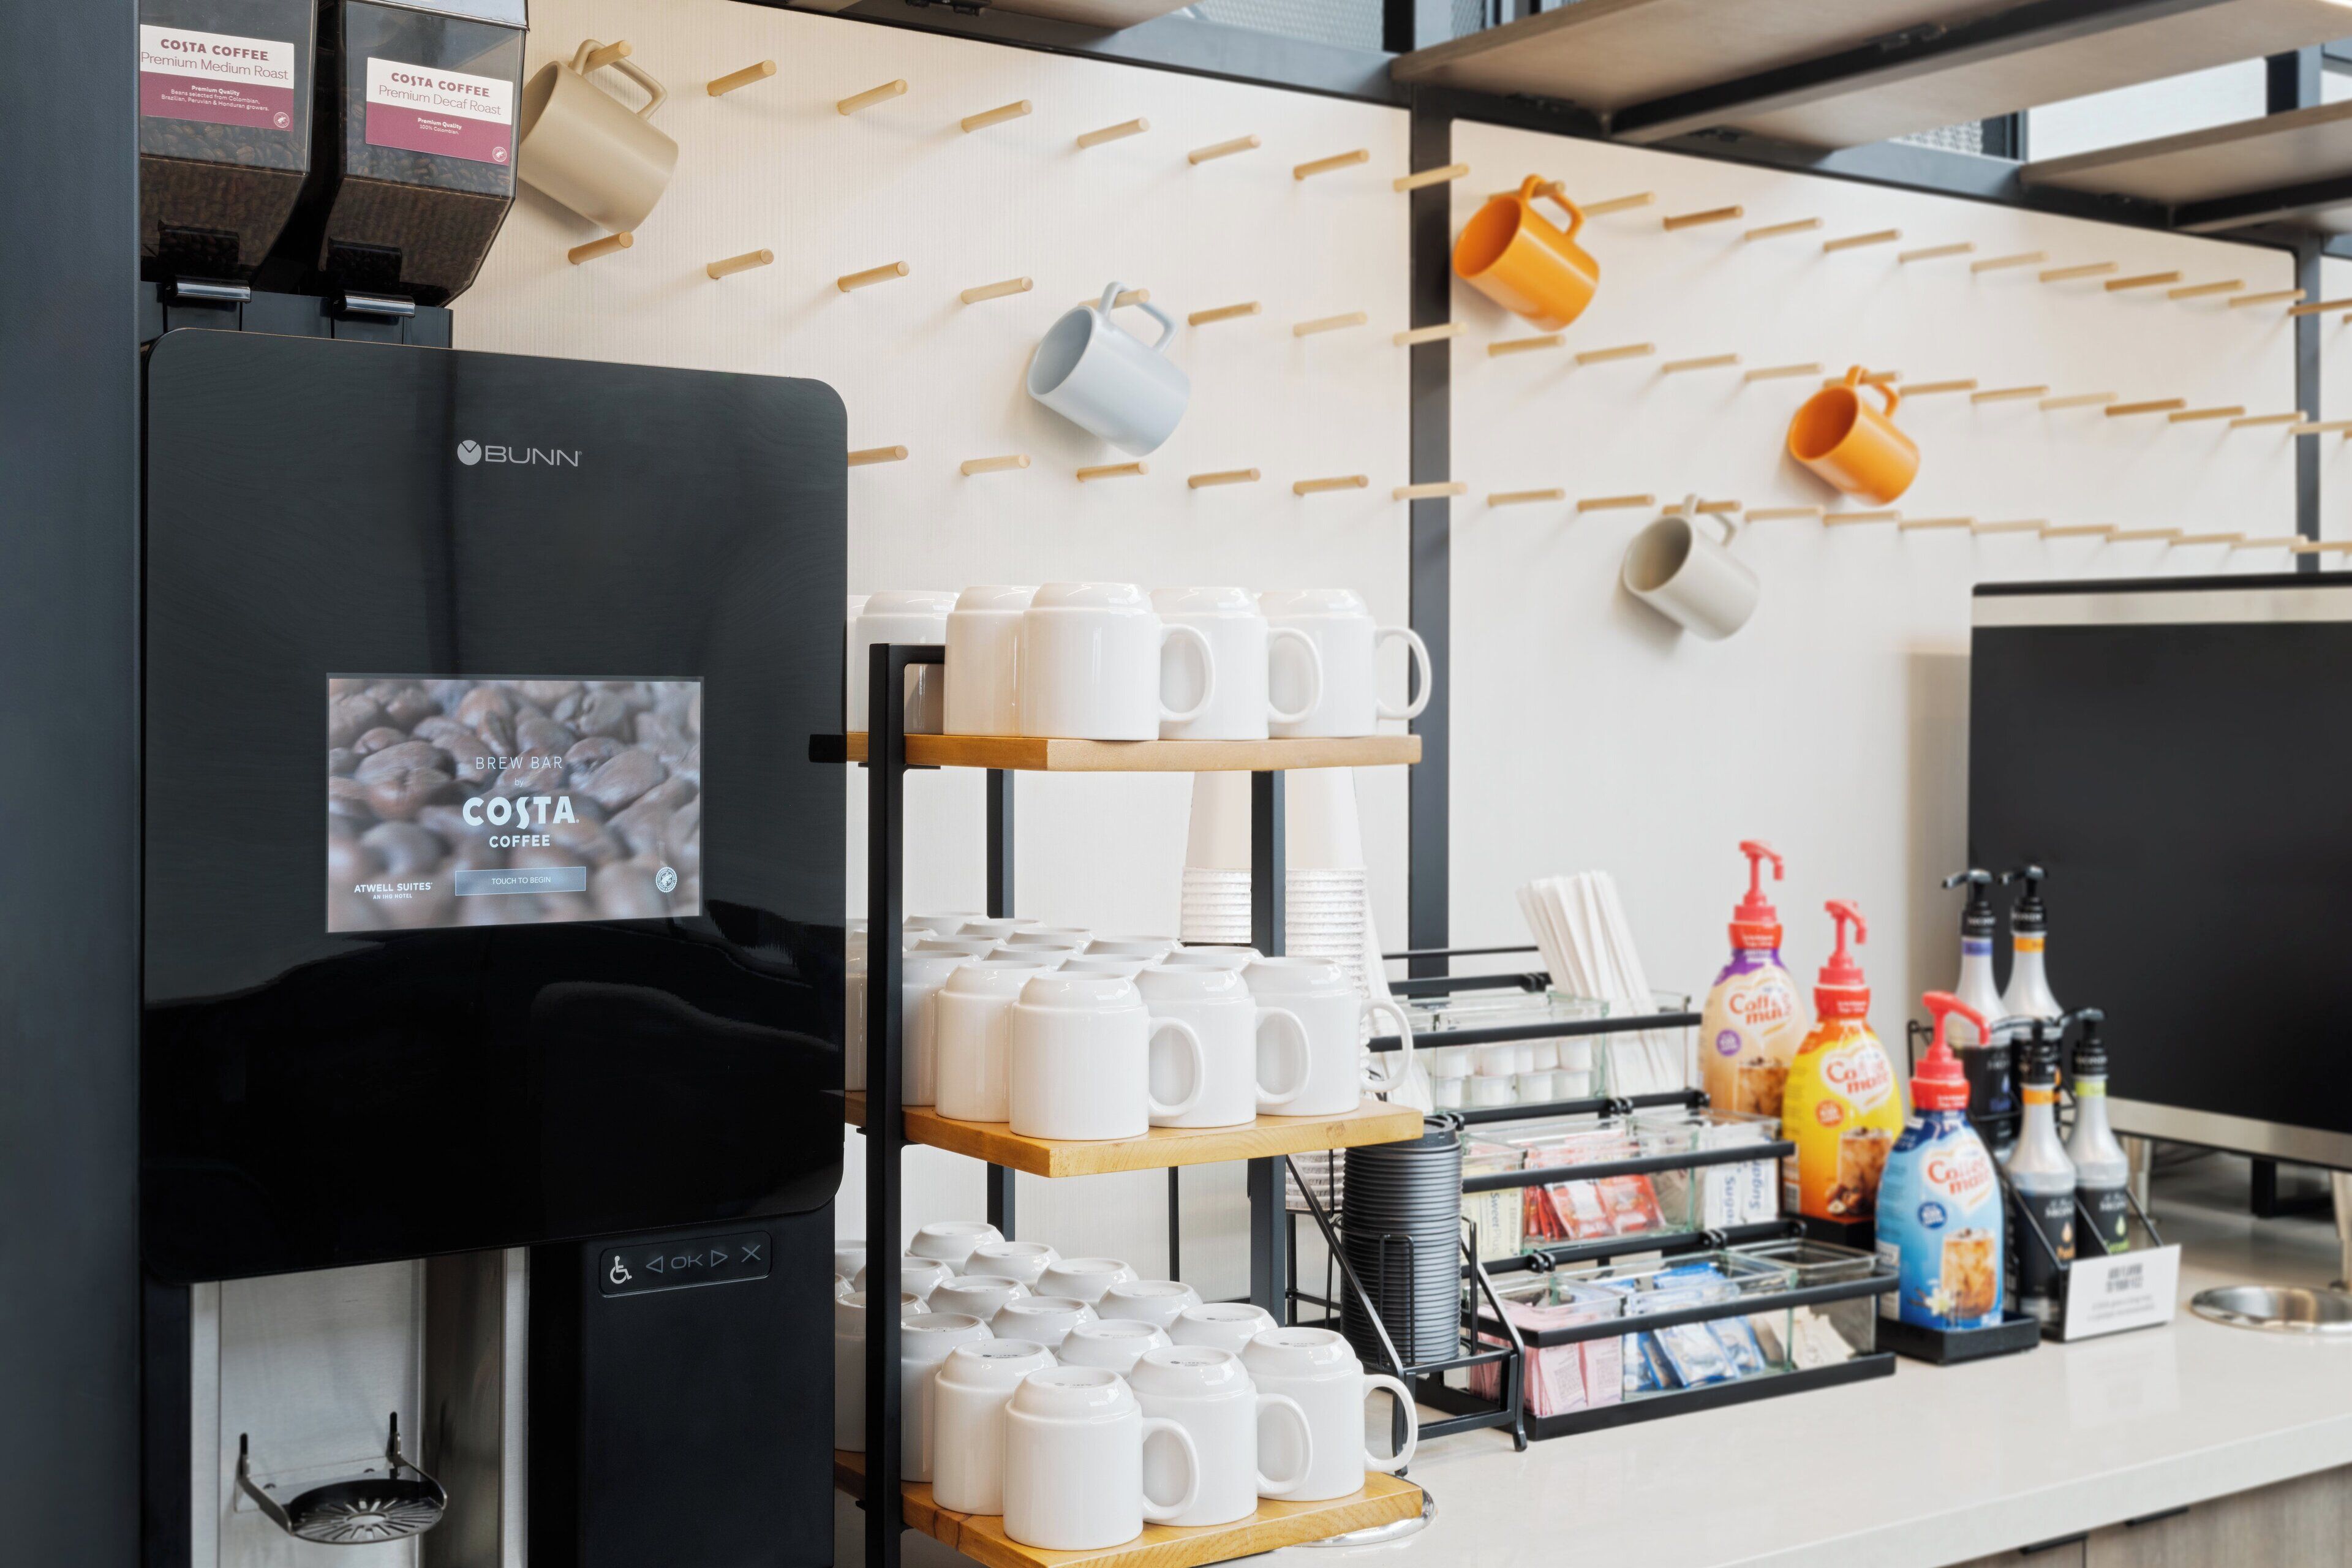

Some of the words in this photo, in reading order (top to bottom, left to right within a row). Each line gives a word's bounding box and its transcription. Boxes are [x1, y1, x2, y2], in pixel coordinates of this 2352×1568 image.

[160, 39, 206, 53] COSTA
[212, 45, 270, 61] COFFEE
[141, 51, 197, 69] Premium
[201, 59, 250, 75] Medium
[255, 66, 288, 80] Roast
[219, 88, 240, 96] Quality
[391, 72, 433, 88] COSTA
[438, 81, 490, 98] COFFEE
[379, 85, 429, 103] Premium
[434, 94, 467, 109] Decaf
[470, 100, 501, 115] Roast
[418, 117, 441, 127] Premium
[442, 121, 462, 130] Quality
[485, 445, 578, 467] BUNN
[476, 757, 523, 769] BREW
[531, 756, 562, 769] BAR
[514, 778, 524, 787] by
[462, 796, 576, 829] COSTA
[489, 835, 550, 848] COFFEE
[354, 884, 393, 893] ATWELL
[397, 883, 431, 892] SUITES
[671, 1254, 703, 1269] OK
